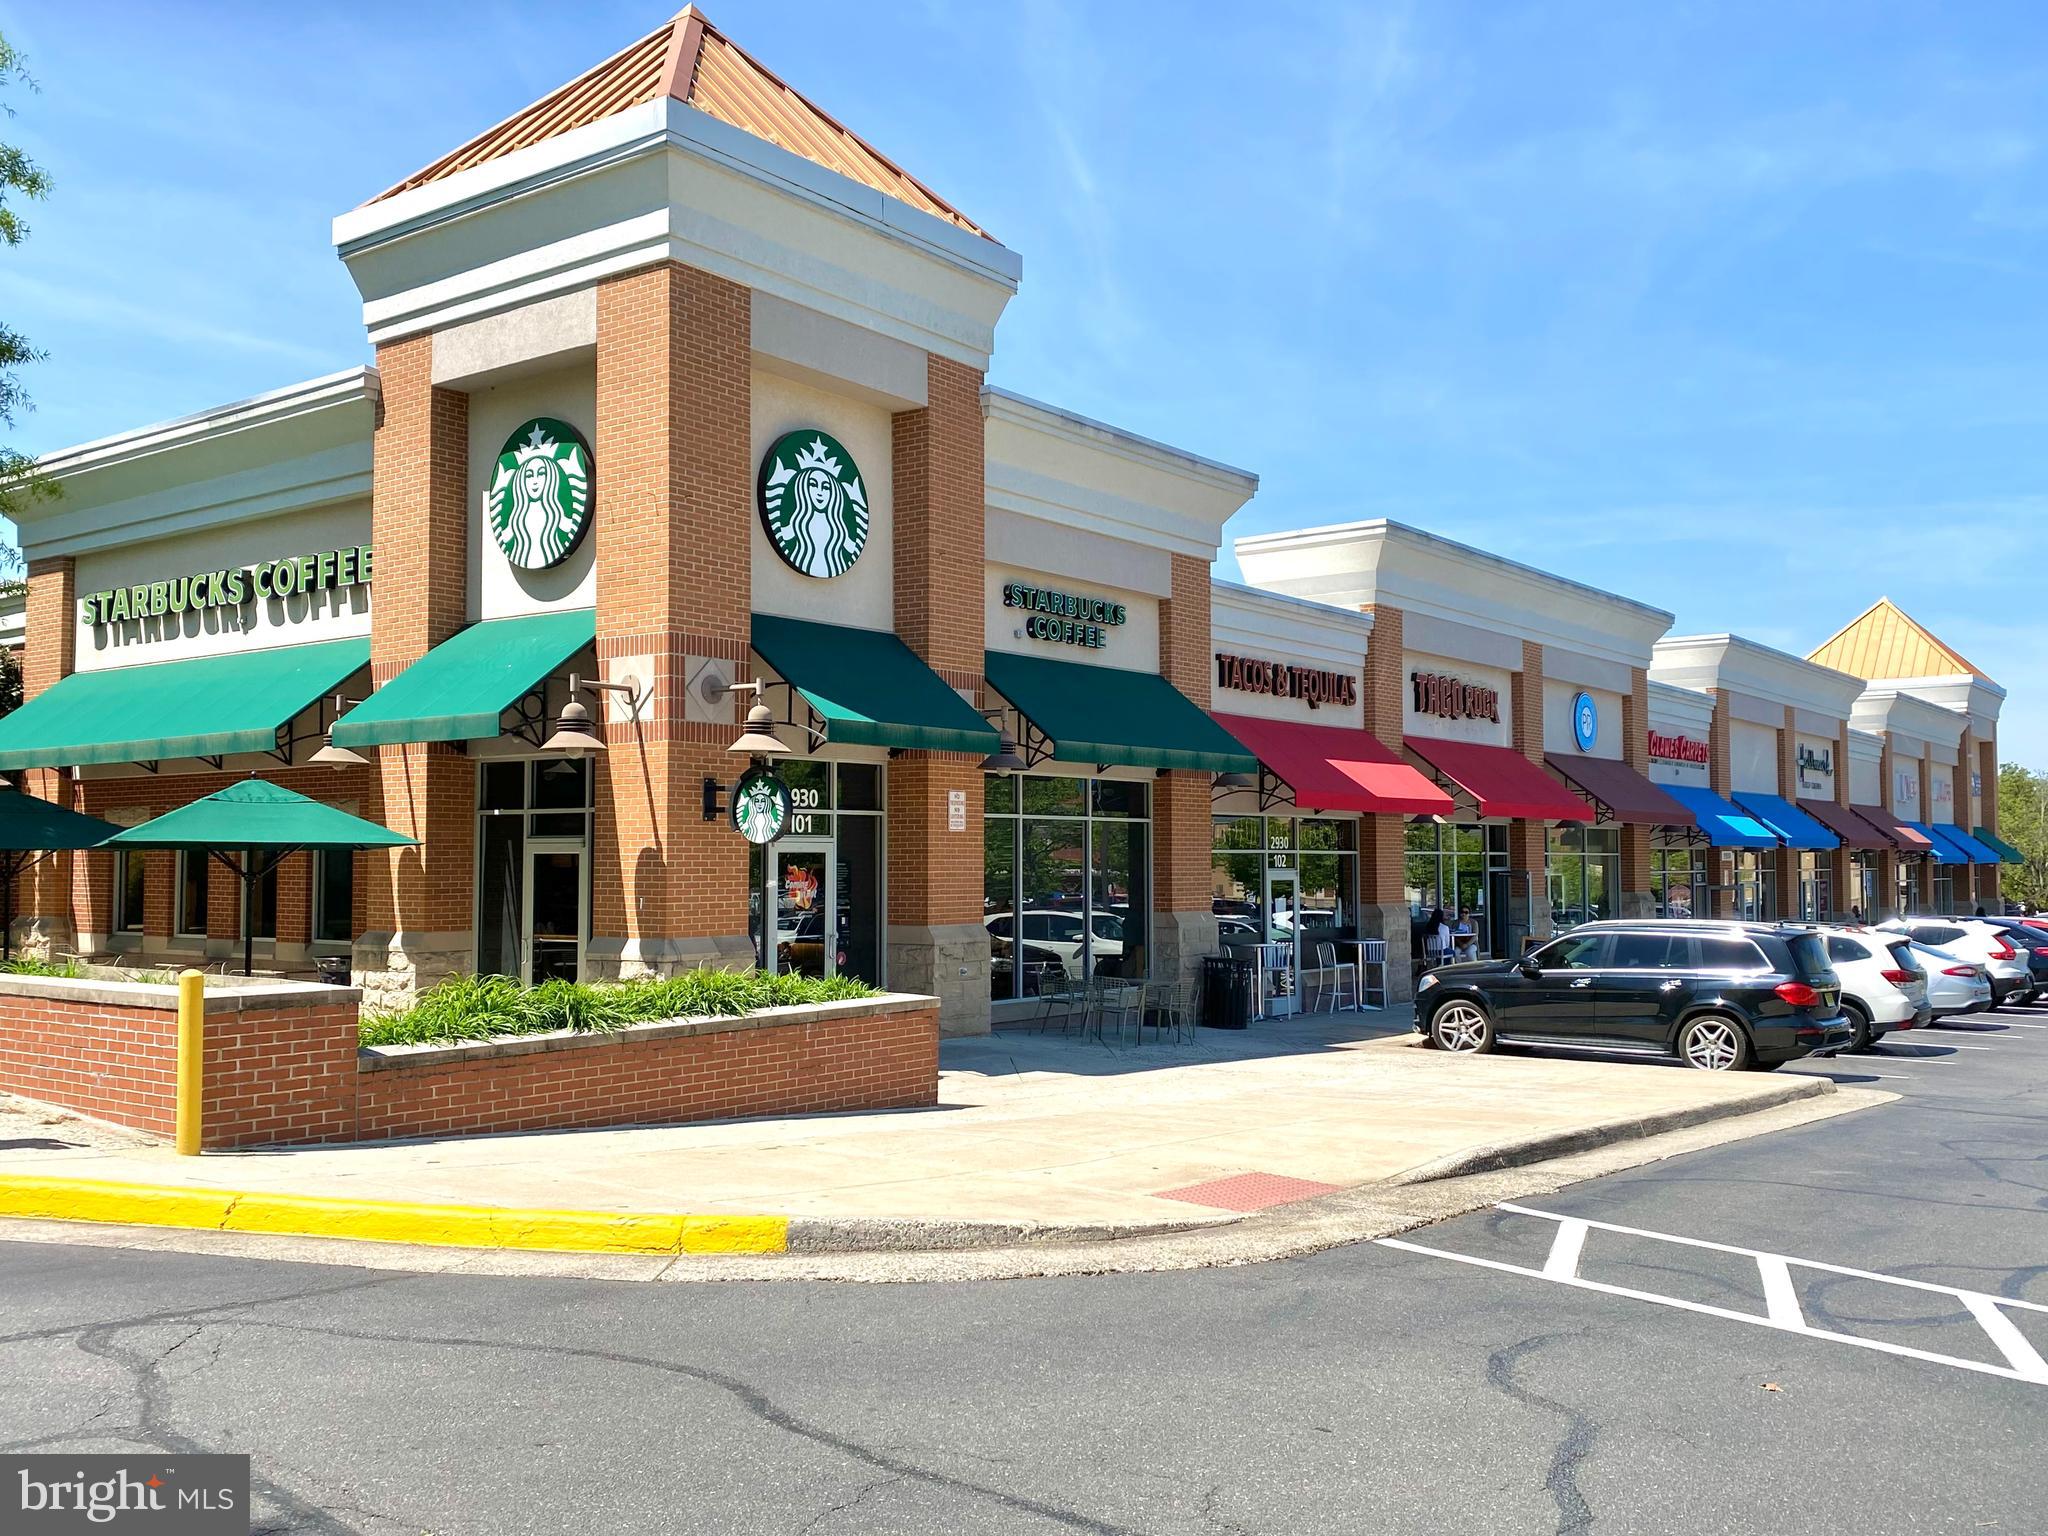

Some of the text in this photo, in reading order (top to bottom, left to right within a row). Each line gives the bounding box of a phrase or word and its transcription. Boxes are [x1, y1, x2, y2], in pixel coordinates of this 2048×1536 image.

[82, 544, 373, 626] STARBUCKS COFFEE
[1007, 583, 1127, 625] STARBUCKS
[1031, 615, 1107, 648] COFFEE
[1218, 653, 1357, 709] TACOS & TEQUILAS
[1413, 672, 1500, 723] TACO ROCK
[791, 788, 819, 808] 930
[1271, 836, 1289, 850] 2930
[1273, 854, 1287, 868] 102
